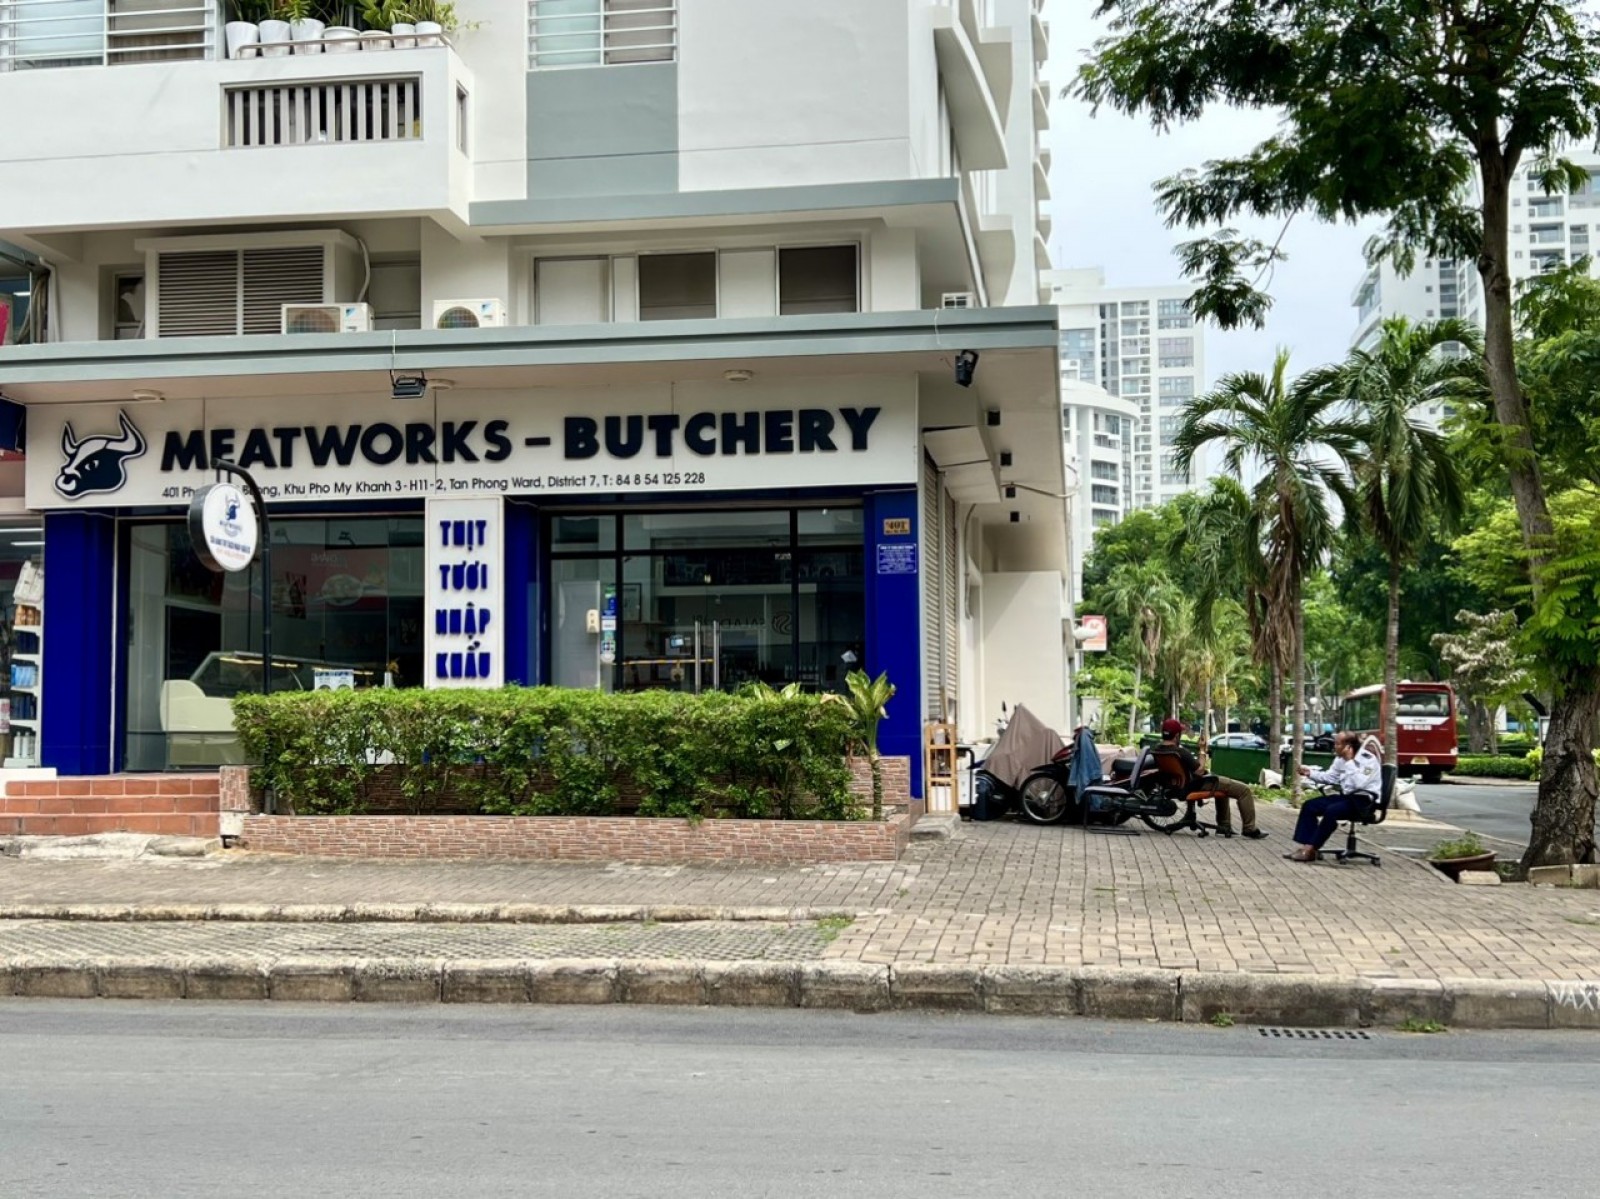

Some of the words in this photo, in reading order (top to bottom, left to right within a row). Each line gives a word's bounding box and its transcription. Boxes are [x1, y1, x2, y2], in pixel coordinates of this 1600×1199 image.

[160, 420, 512, 471] MEATWORKS
[564, 407, 882, 460] BUTCHERY
[162, 486, 179, 498] 401
[284, 483, 306, 495] Khu
[309, 482, 331, 494] Pho
[334, 481, 351, 496] My
[356, 480, 392, 493] Khanh
[449, 478, 469, 490] Tan
[472, 477, 509, 492] Phong
[511, 476, 545, 490] Ward,
[547, 475, 586, 488] District
[615, 474, 631, 486] 84
[633, 474, 641, 486] 8
[644, 473, 659, 485] 54
[662, 472, 681, 485] 125
[684, 472, 706, 485] 228
[439, 519, 487, 551] THỊT
[439, 560, 488, 590] TƯƠI
[435, 602, 491, 640] NHẬP
[1548, 983, 1600, 1011] VAX
